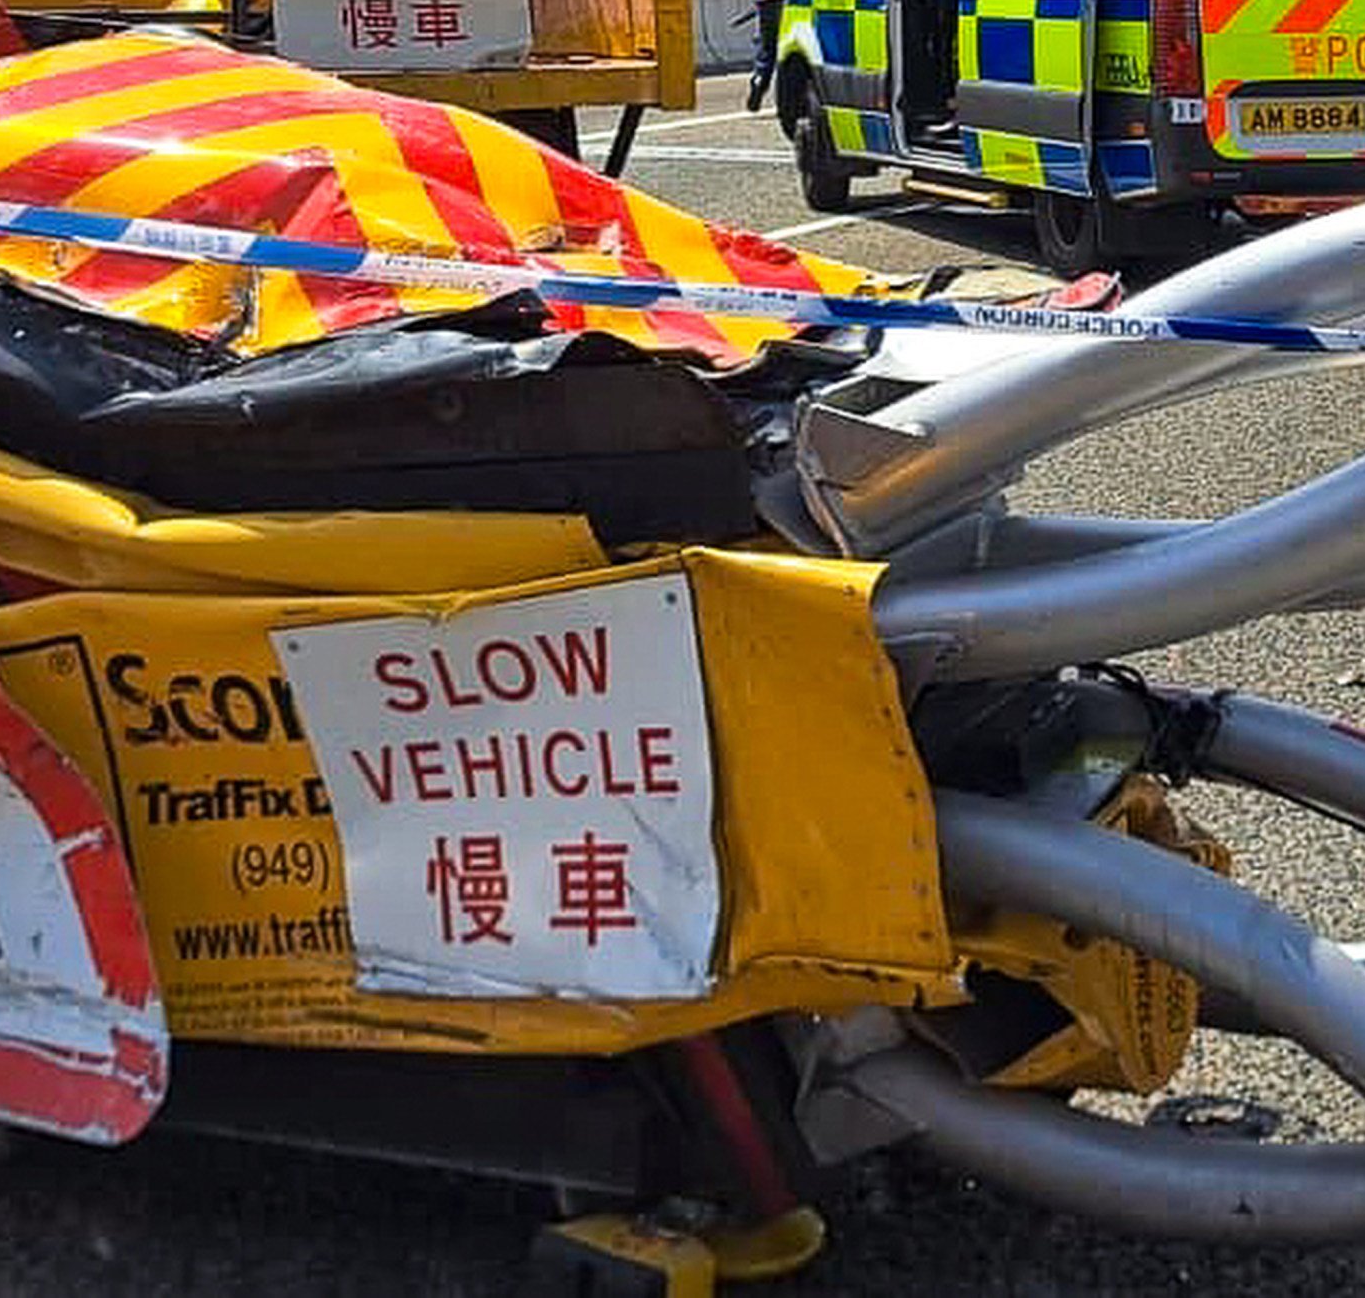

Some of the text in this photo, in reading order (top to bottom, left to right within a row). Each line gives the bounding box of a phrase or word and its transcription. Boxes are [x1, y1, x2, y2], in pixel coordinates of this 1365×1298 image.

[1250, 104, 1360, 132] AM 8884
[974, 305, 1160, 337] POLICE CORDON
[375, 627, 608, 713] SLOW
[351, 727, 680, 804] VEHICLE
[231, 841, 330, 897] (949)
[427, 831, 637, 947] 慢車
